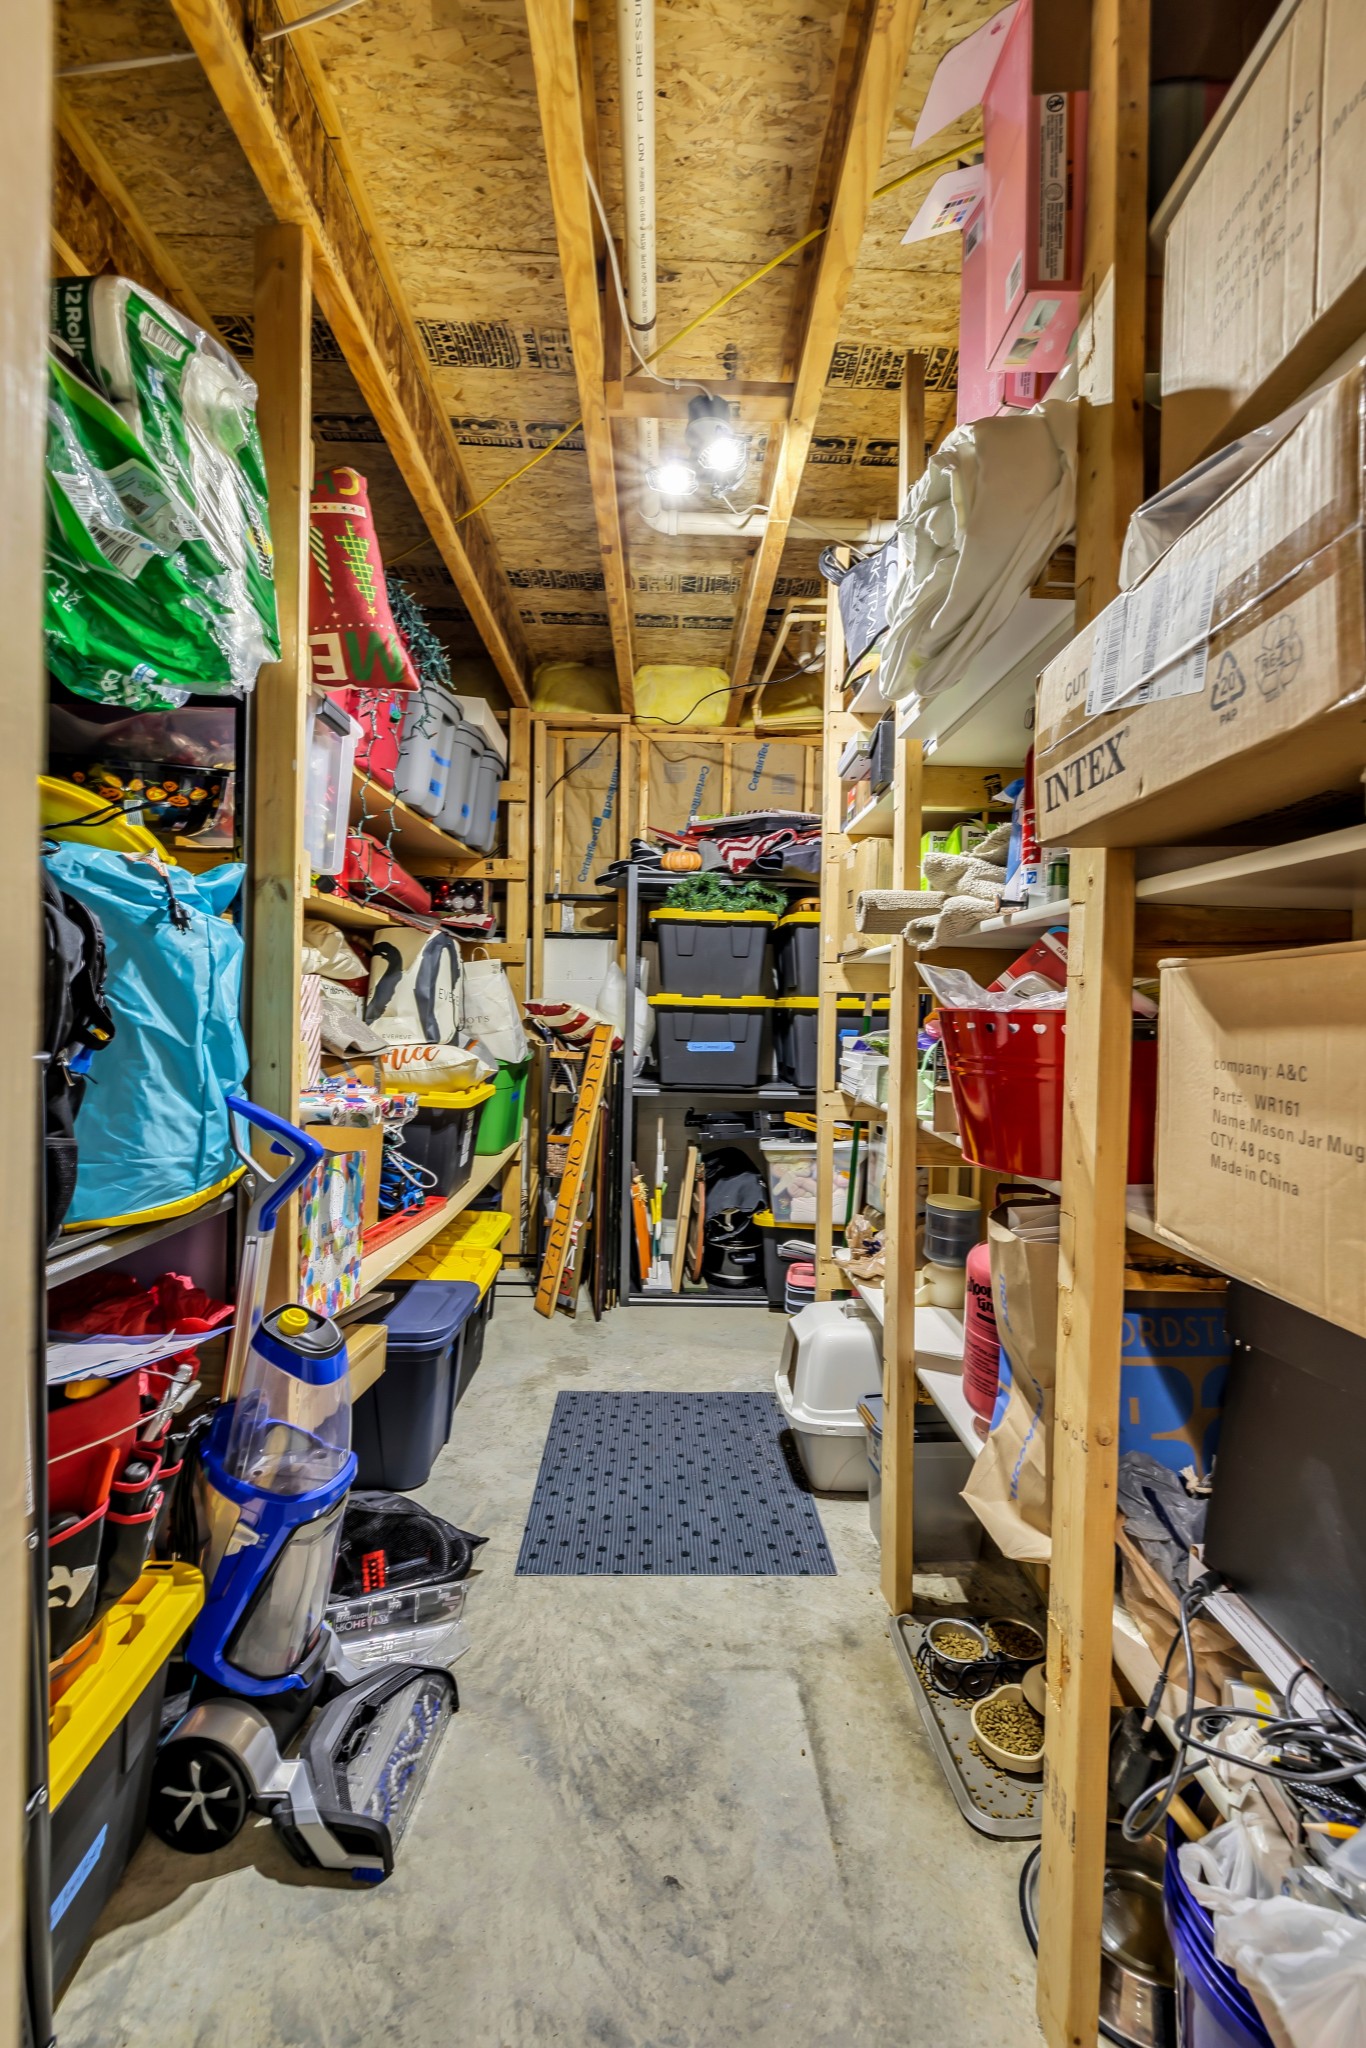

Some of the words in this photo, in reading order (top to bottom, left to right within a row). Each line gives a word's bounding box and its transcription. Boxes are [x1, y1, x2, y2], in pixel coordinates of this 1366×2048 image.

[635, 0, 644, 78] PRESSU
[65, 283, 83, 305] 12
[437, 323, 459, 365] DOWN
[61, 589, 86, 613] FSC
[1219, 671, 1236, 696] 20
[1219, 710, 1238, 726] PAP
[1044, 730, 1127, 813] INTEX
[575, 1038, 607, 1125] TRICK
[1214, 1060, 1273, 1081] company:
[1276, 1063, 1309, 1083] A&C
[1254, 1094, 1300, 1118] WR161
[564, 1138, 584, 1183] OR
[1211, 1131, 1238, 1152] QTY:
[1240, 1140, 1255, 1158] 48
[1258, 1149, 1281, 1166] pcs
[1298, 1130, 1323, 1149] Jar
[1327, 1134, 1366, 1164] Mug
[1210, 1153, 1242, 1177] Made
[1245, 1164, 1257, 1182] in
[1260, 1169, 1300, 1197] China
[540, 1201, 573, 1309] TREAT
[1121, 1315, 1230, 1348] ORDST
